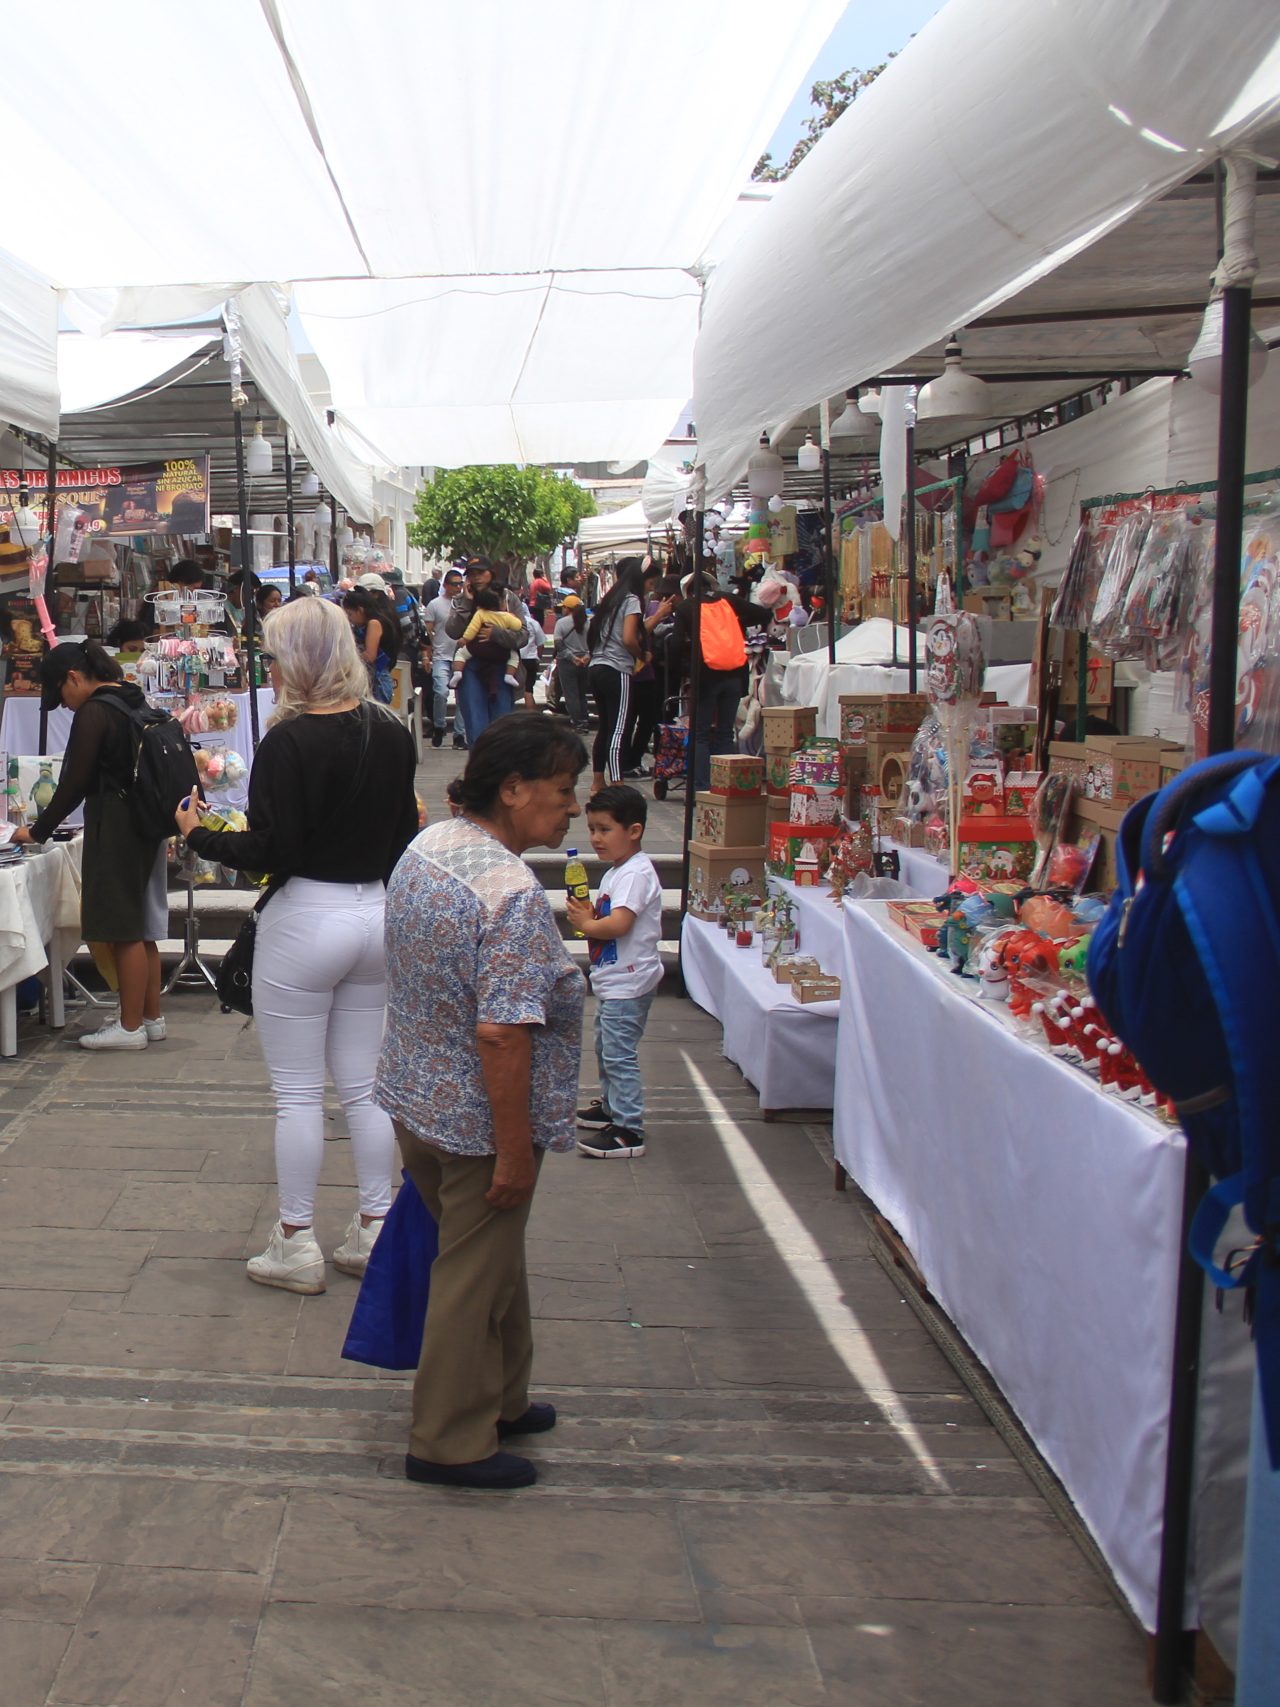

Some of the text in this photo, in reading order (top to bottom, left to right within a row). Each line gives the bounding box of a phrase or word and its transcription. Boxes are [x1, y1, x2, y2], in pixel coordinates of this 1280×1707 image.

[164, 460, 195, 472] 100%
[23, 467, 121, 489] ORANICOS
[162, 469, 198, 478] NATURAL
[167, 482, 204, 491] BROMATO
